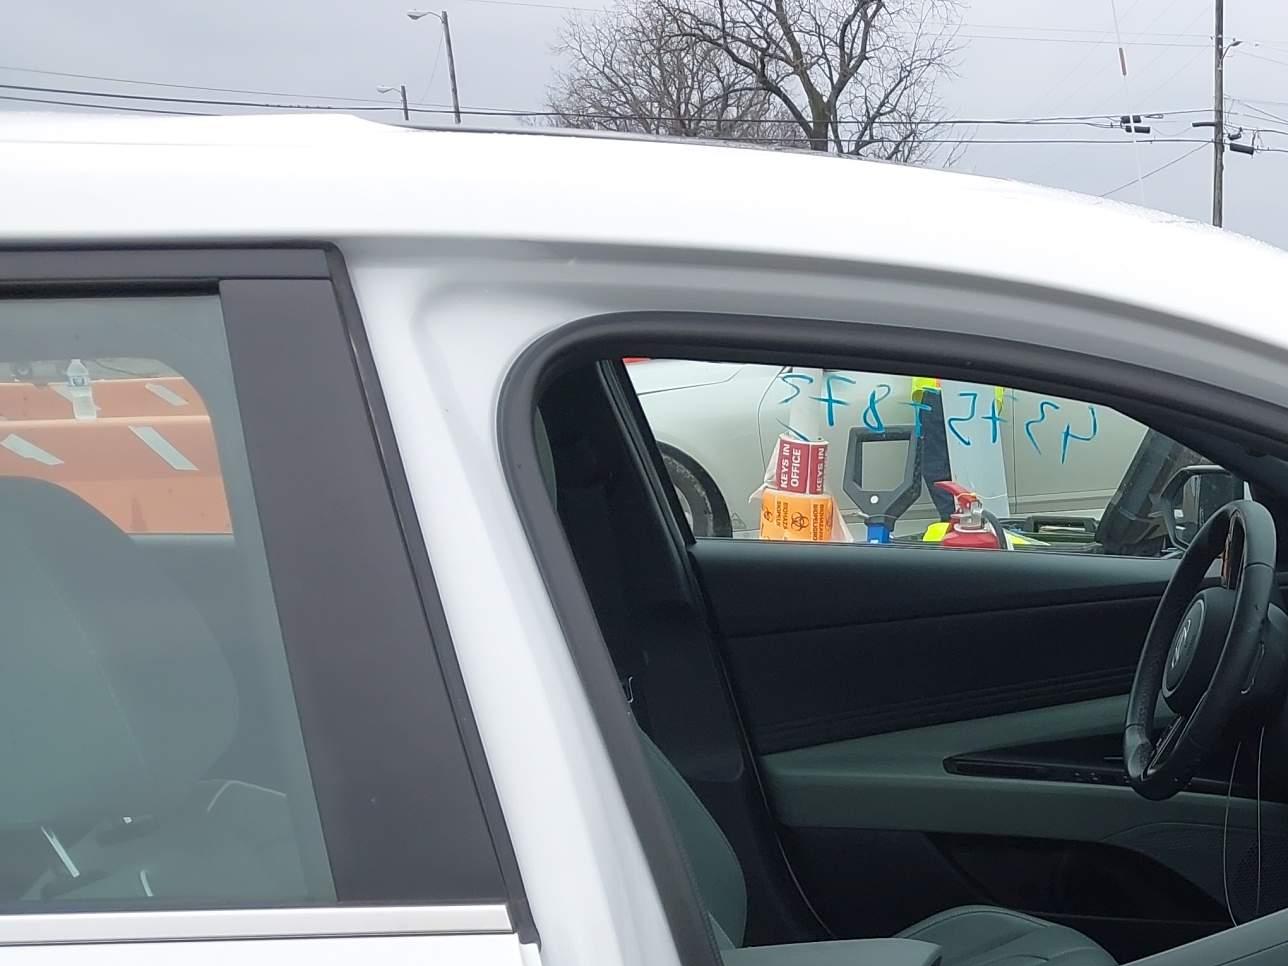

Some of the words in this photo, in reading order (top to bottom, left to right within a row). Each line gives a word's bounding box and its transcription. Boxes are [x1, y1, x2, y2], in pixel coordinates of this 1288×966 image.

[782, 443, 791, 456] IN
[817, 447, 825, 460] IN
[780, 458, 790, 489] KEYS
[790, 448, 801, 488] OFFICE
[816, 463, 824, 491] KEYS
